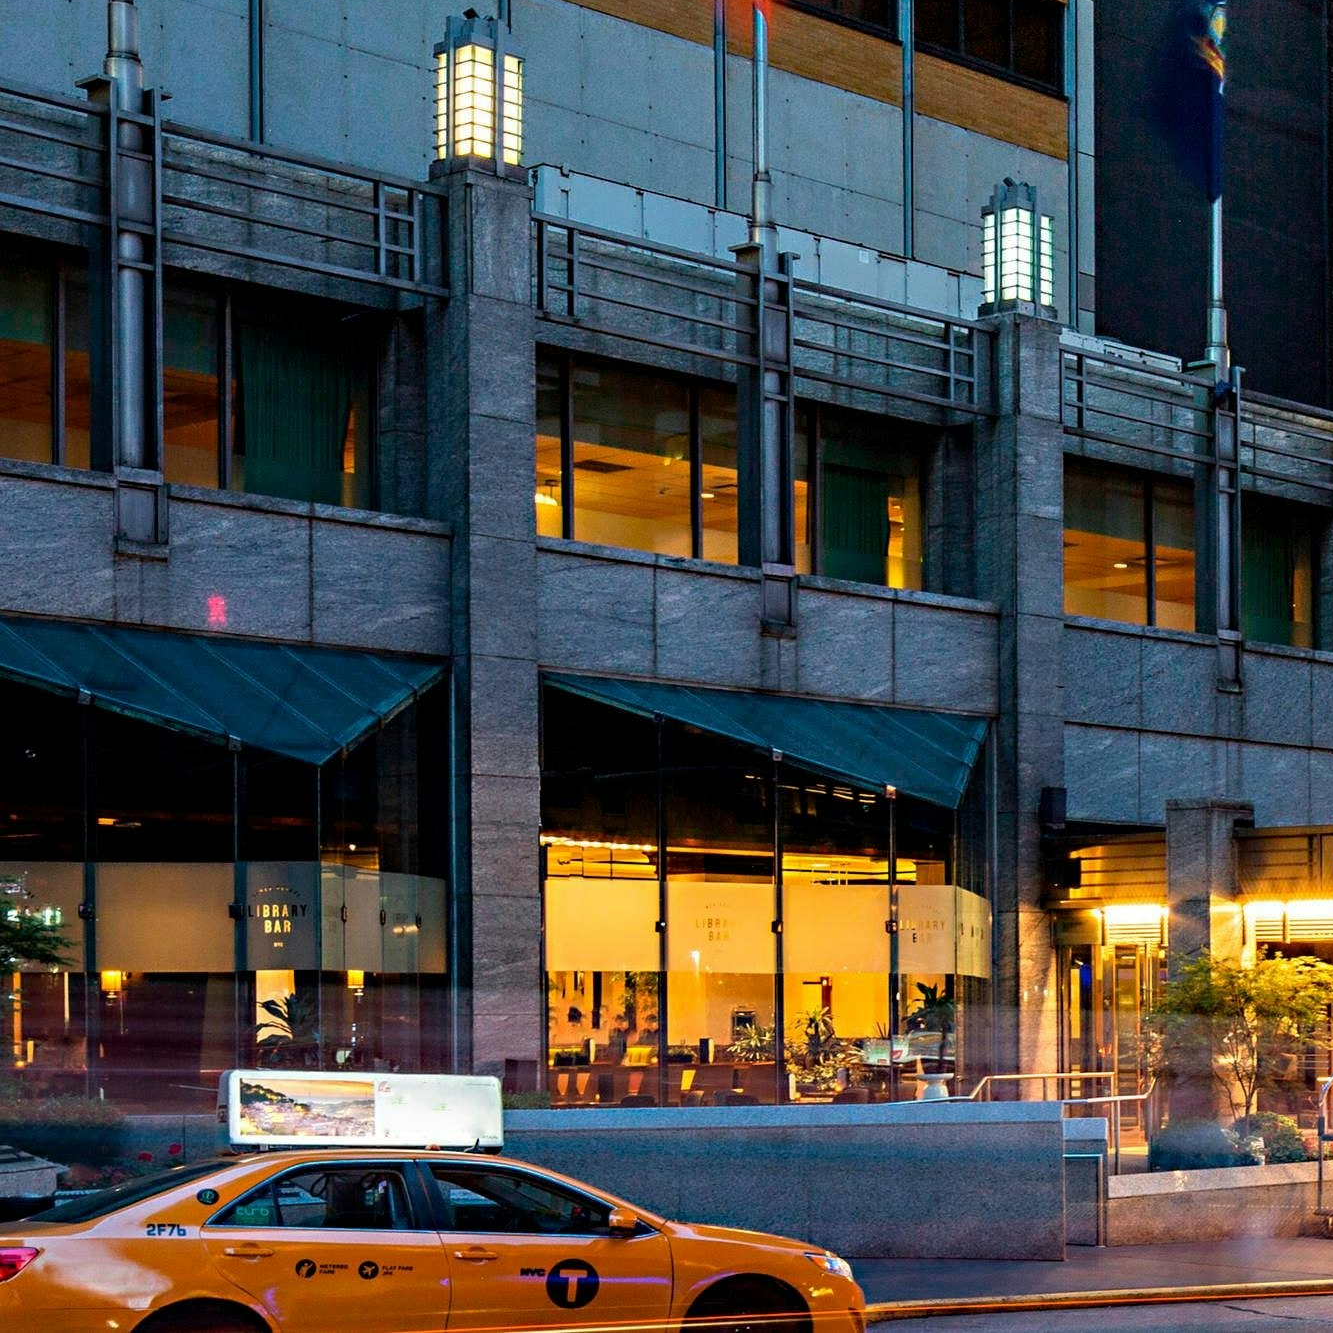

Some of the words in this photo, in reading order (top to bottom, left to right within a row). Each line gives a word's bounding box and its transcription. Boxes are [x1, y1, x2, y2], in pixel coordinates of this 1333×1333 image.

[248, 904, 308, 918] LIBRARY
[264, 919, 291, 934] BAR
[236, 1207, 270, 1217] curb
[520, 1267, 546, 1277] NYC
[560, 1269, 588, 1303] T
